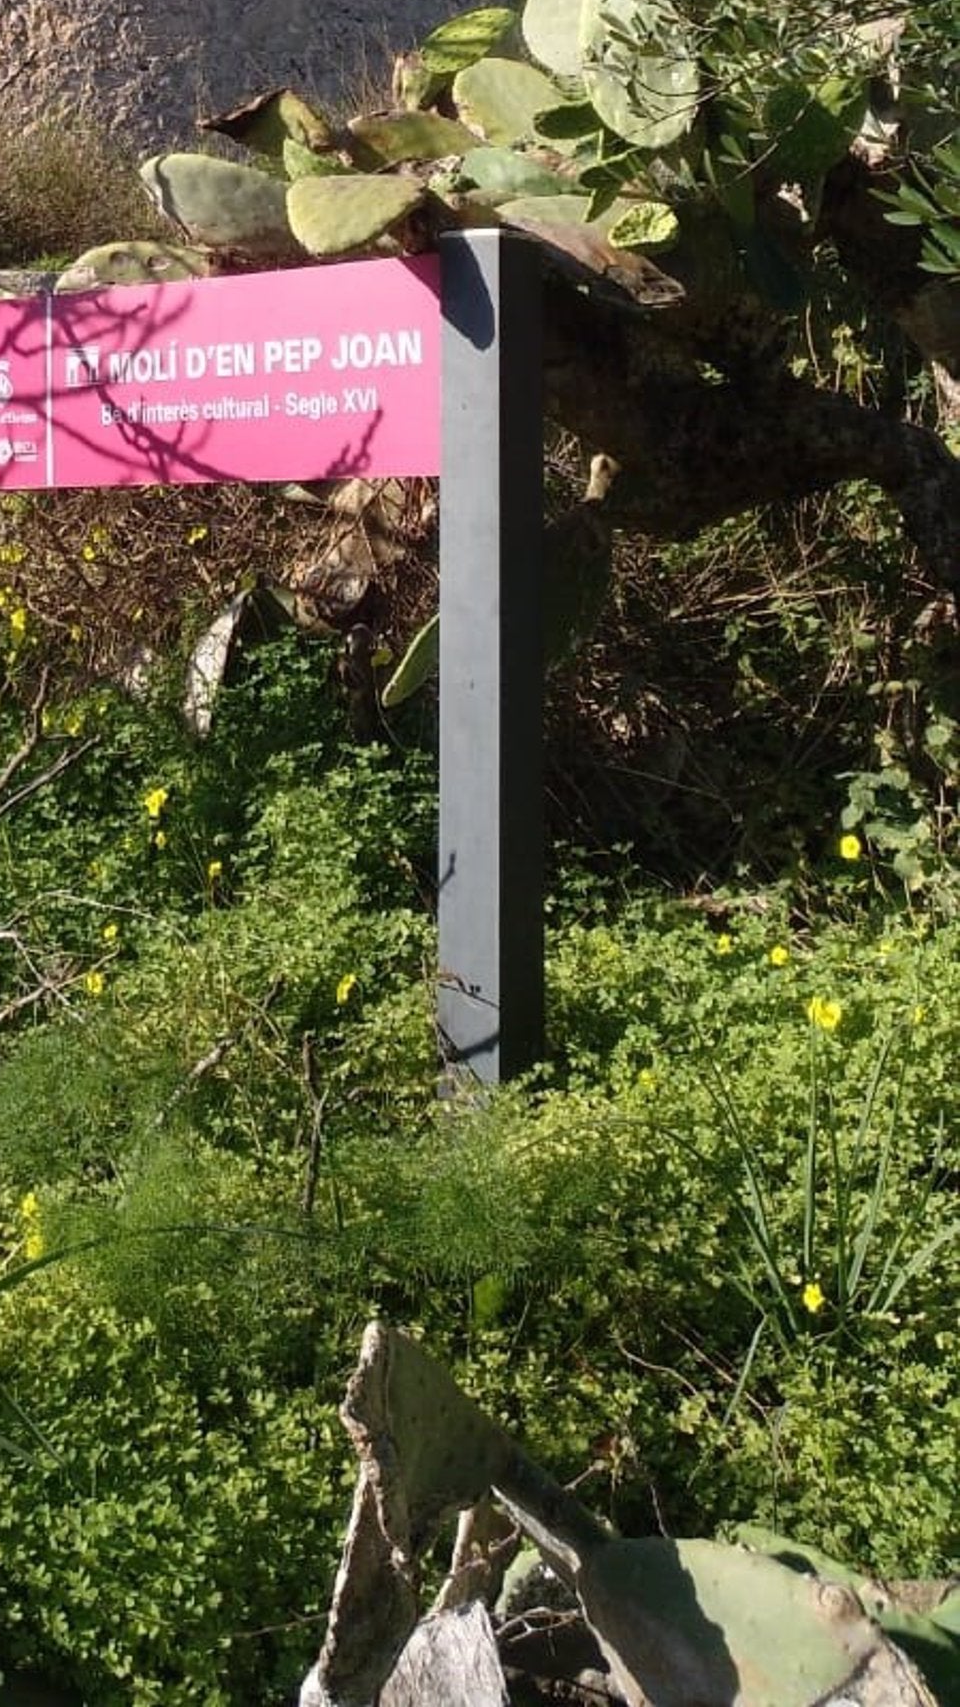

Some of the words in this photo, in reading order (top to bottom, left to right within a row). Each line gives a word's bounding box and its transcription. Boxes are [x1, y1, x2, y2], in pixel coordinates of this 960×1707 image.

[109, 340, 177, 384] MOLÍ
[186, 342, 255, 380] D'EN
[264, 336, 323, 374] PEP
[330, 329, 423, 371] JOAN
[202, 394, 270, 421] cultural
[285, 391, 338, 420] Segle
[342, 386, 378, 413] XVI
